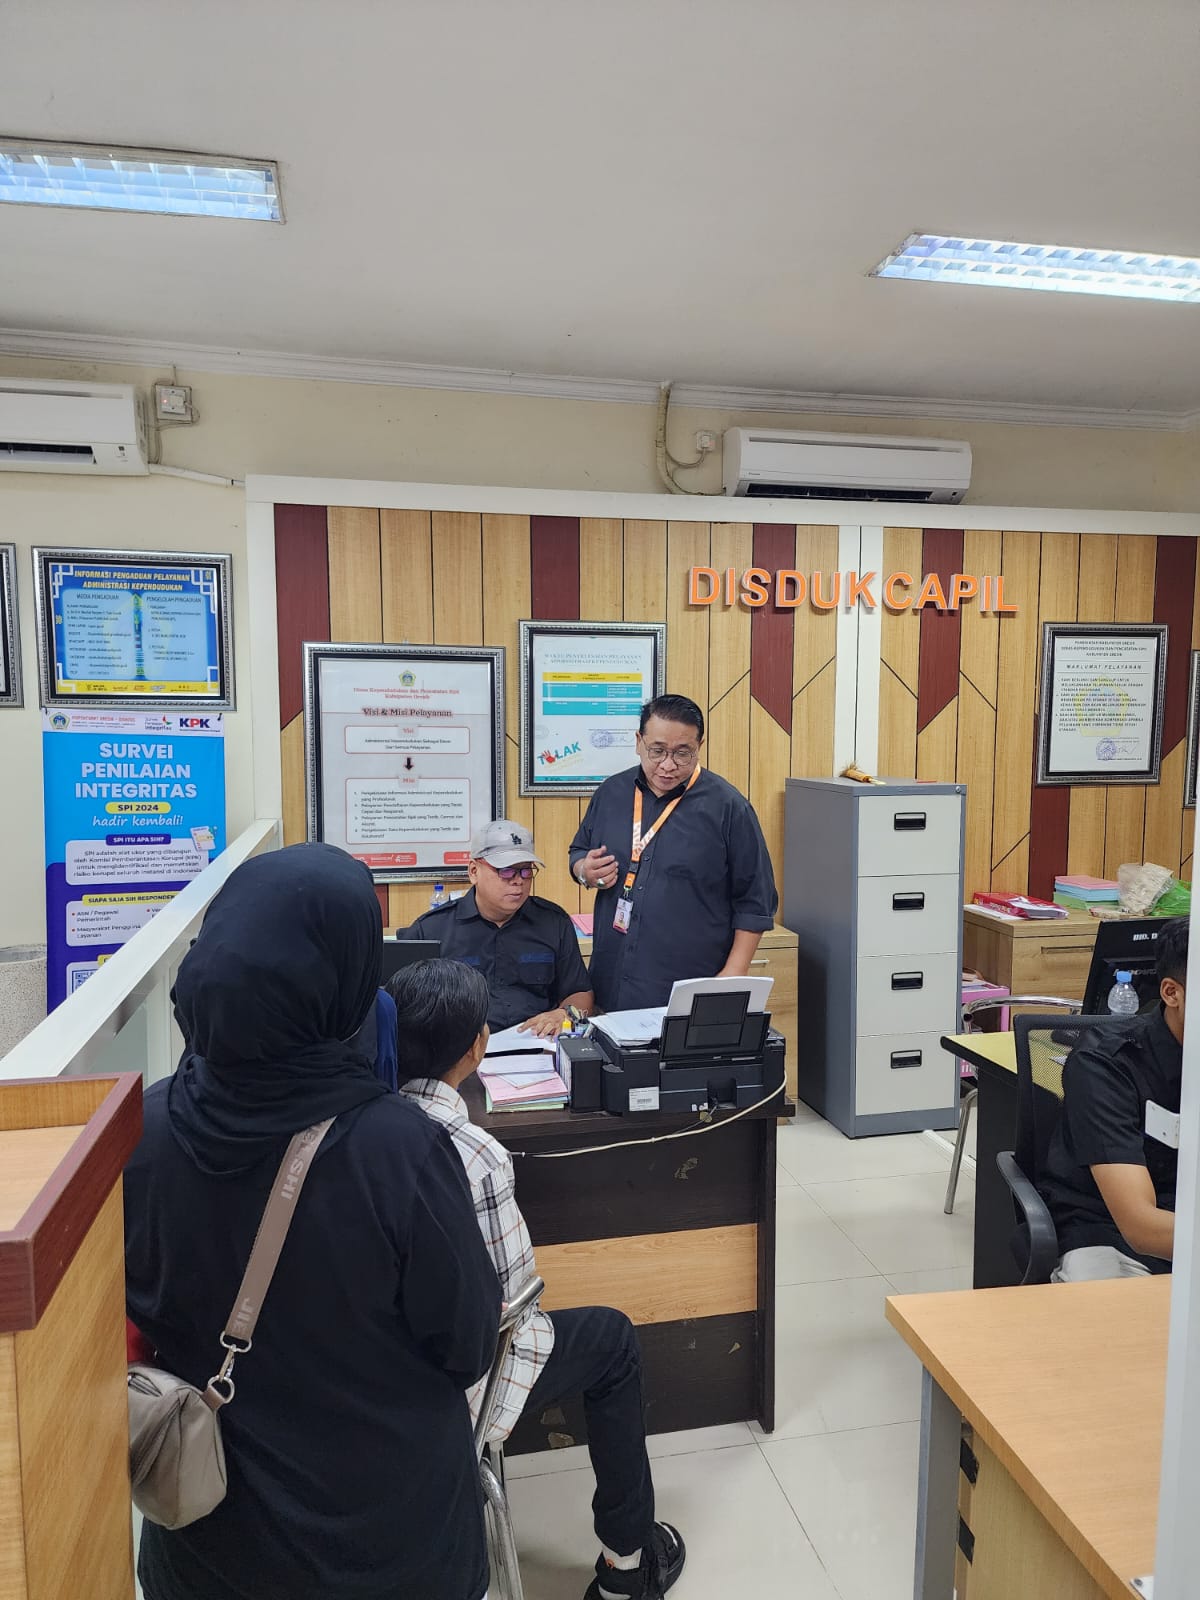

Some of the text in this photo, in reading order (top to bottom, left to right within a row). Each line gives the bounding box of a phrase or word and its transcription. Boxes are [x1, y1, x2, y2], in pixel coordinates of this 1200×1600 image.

[75, 570, 191, 581] INFORMASI PENGADUAN PELAYANAN
[83, 581, 183, 591] ADMINISTRASI KEPENDUDUKAN
[688, 566, 1020, 612] DISDUKCAPIL
[362, 708, 452, 719] Visi & Misi Pelayanan
[179, 717, 211, 729] KPK
[99, 742, 173, 760] SURVEI
[81, 762, 191, 779] PENILAIAN
[75, 782, 198, 799] INTEGRITAS
[135, 804, 159, 812] 2024
[92, 814, 184, 827] hadir kembali!
